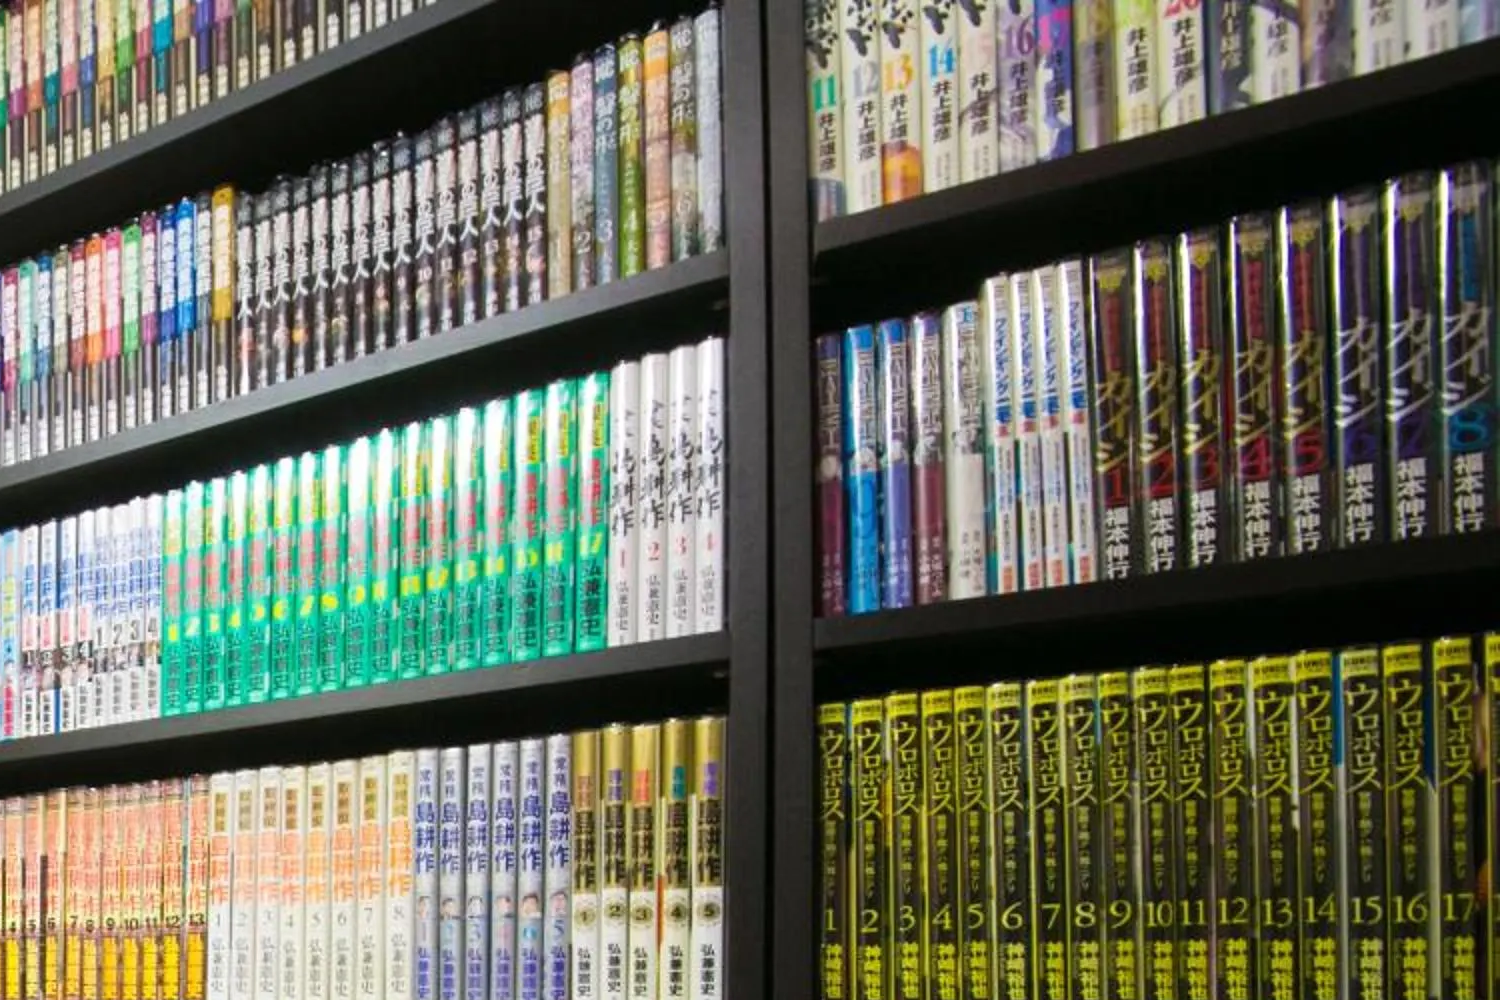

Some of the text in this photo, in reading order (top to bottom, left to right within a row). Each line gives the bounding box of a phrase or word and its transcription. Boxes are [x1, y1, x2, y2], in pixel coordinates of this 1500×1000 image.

[884, 54, 912, 91] 13
[929, 44, 955, 79] 14
[1005, 18, 1033, 59] 16
[811, 75, 837, 112] 11
[853, 62, 879, 96] 12
[577, 232, 590, 252] 2
[1190, 489, 1216, 565] 福本伸行
[1244, 481, 1270, 557] 福本伸行
[1291, 474, 1321, 552] 福本伸行
[1344, 463, 1374, 543] 福本伸行
[1397, 457, 1427, 538] 福本伸行
[1453, 452, 1484, 533] 福本伸行
[1105, 507, 1130, 580] 福本伸行
[1149, 497, 1174, 573] 福本伸行
[960, 715, 989, 812] ウロボロス
[994, 713, 1024, 812] ウロボロス
[1033, 711, 1060, 809] ウロボロス
[1068, 706, 1098, 807] ウロボロス
[1103, 702, 1129, 801] ウロボロス
[1140, 702, 1171, 799] ウロボロス
[1172, 698, 1207, 800] ウロボロス
[1213, 692, 1247, 798] ウロボロス
[1255, 692, 1294, 797] ウロボロス
[1299, 685, 1336, 791] ウロボロス
[1346, 683, 1382, 794] ウロボロス
[1387, 679, 1426, 790] ウロボロス
[1437, 673, 1473, 786] ウロボロス
[821, 730, 844, 820] ウロボロス
[856, 728, 883, 820] ウロボロス
[892, 721, 919, 816] ウロボロス
[926, 719, 954, 815] ウロボロス
[826, 909, 837, 931] 1
[861, 909, 878, 933] 2
[900, 905, 916, 931] 3
[932, 903, 952, 929] 4
[967, 903, 984, 929] 5
[1001, 902, 1023, 929] 6
[1041, 903, 1061, 929] 7
[1075, 902, 1097, 928] 8
[1109, 900, 1132, 928] 9
[1147, 900, 1173, 928] 10
[1181, 899, 1206, 926] 11
[1218, 898, 1248, 926] 12
[1263, 898, 1294, 928] 13
[1304, 893, 1336, 924] 14
[1352, 896, 1382, 924] 15
[1392, 895, 1428, 923] 16
[1443, 893, 1474, 922] 17
